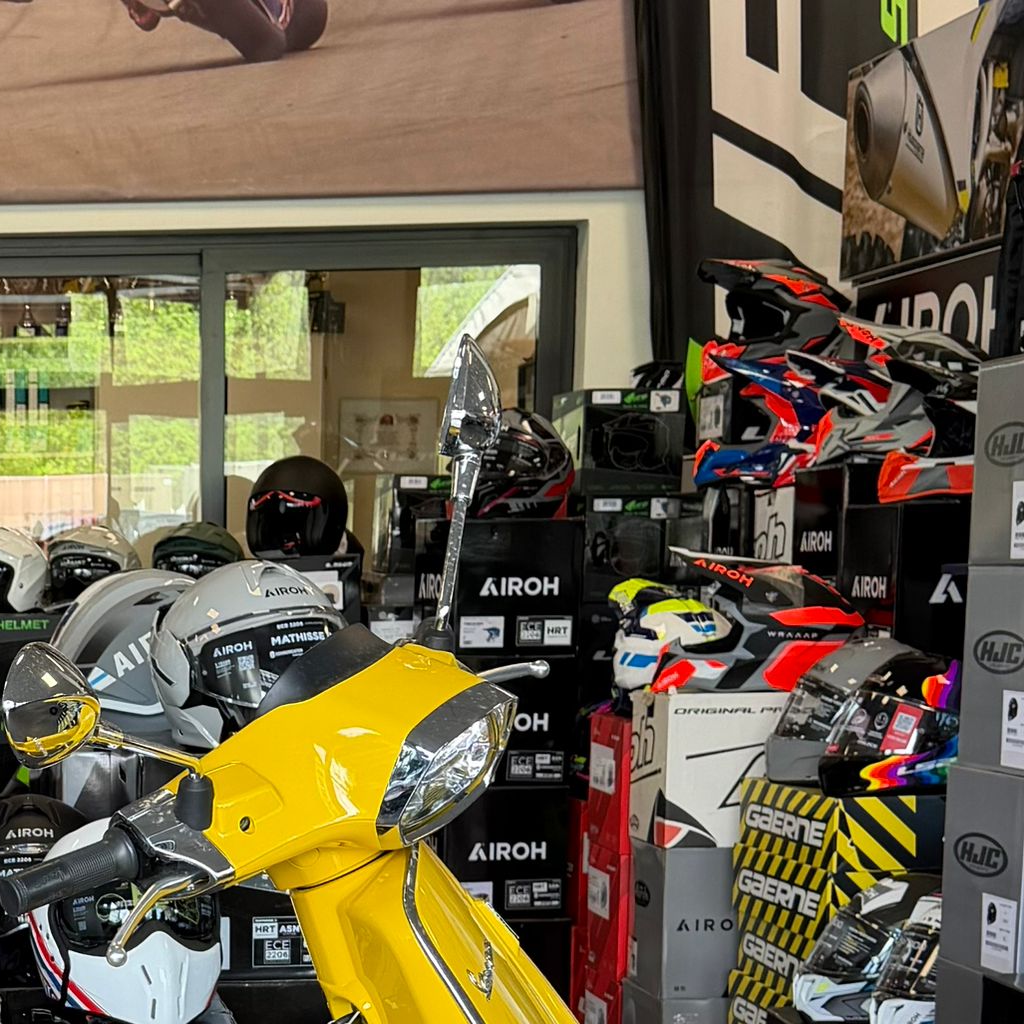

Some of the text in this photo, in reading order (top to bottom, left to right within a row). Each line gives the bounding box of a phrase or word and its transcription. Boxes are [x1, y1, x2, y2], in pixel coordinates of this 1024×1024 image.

[800, 531, 833, 552] AIROH
[693, 558, 754, 588] AIROH
[265, 586, 309, 598] AIROH
[479, 576, 560, 597] AIROH
[851, 576, 887, 599] AIROH
[270, 631, 326, 646] MATHISSE
[213, 641, 253, 658] AIROH
[980, 641, 1022, 664] HJC
[674, 706, 757, 715] ORIGINAL
[5, 828, 54, 840] AIROH
[468, 841, 547, 861] AIROH
[960, 841, 1001, 870] HJC
[255, 925, 300, 933] HRT ASN
[265, 940, 290, 950] ECE
